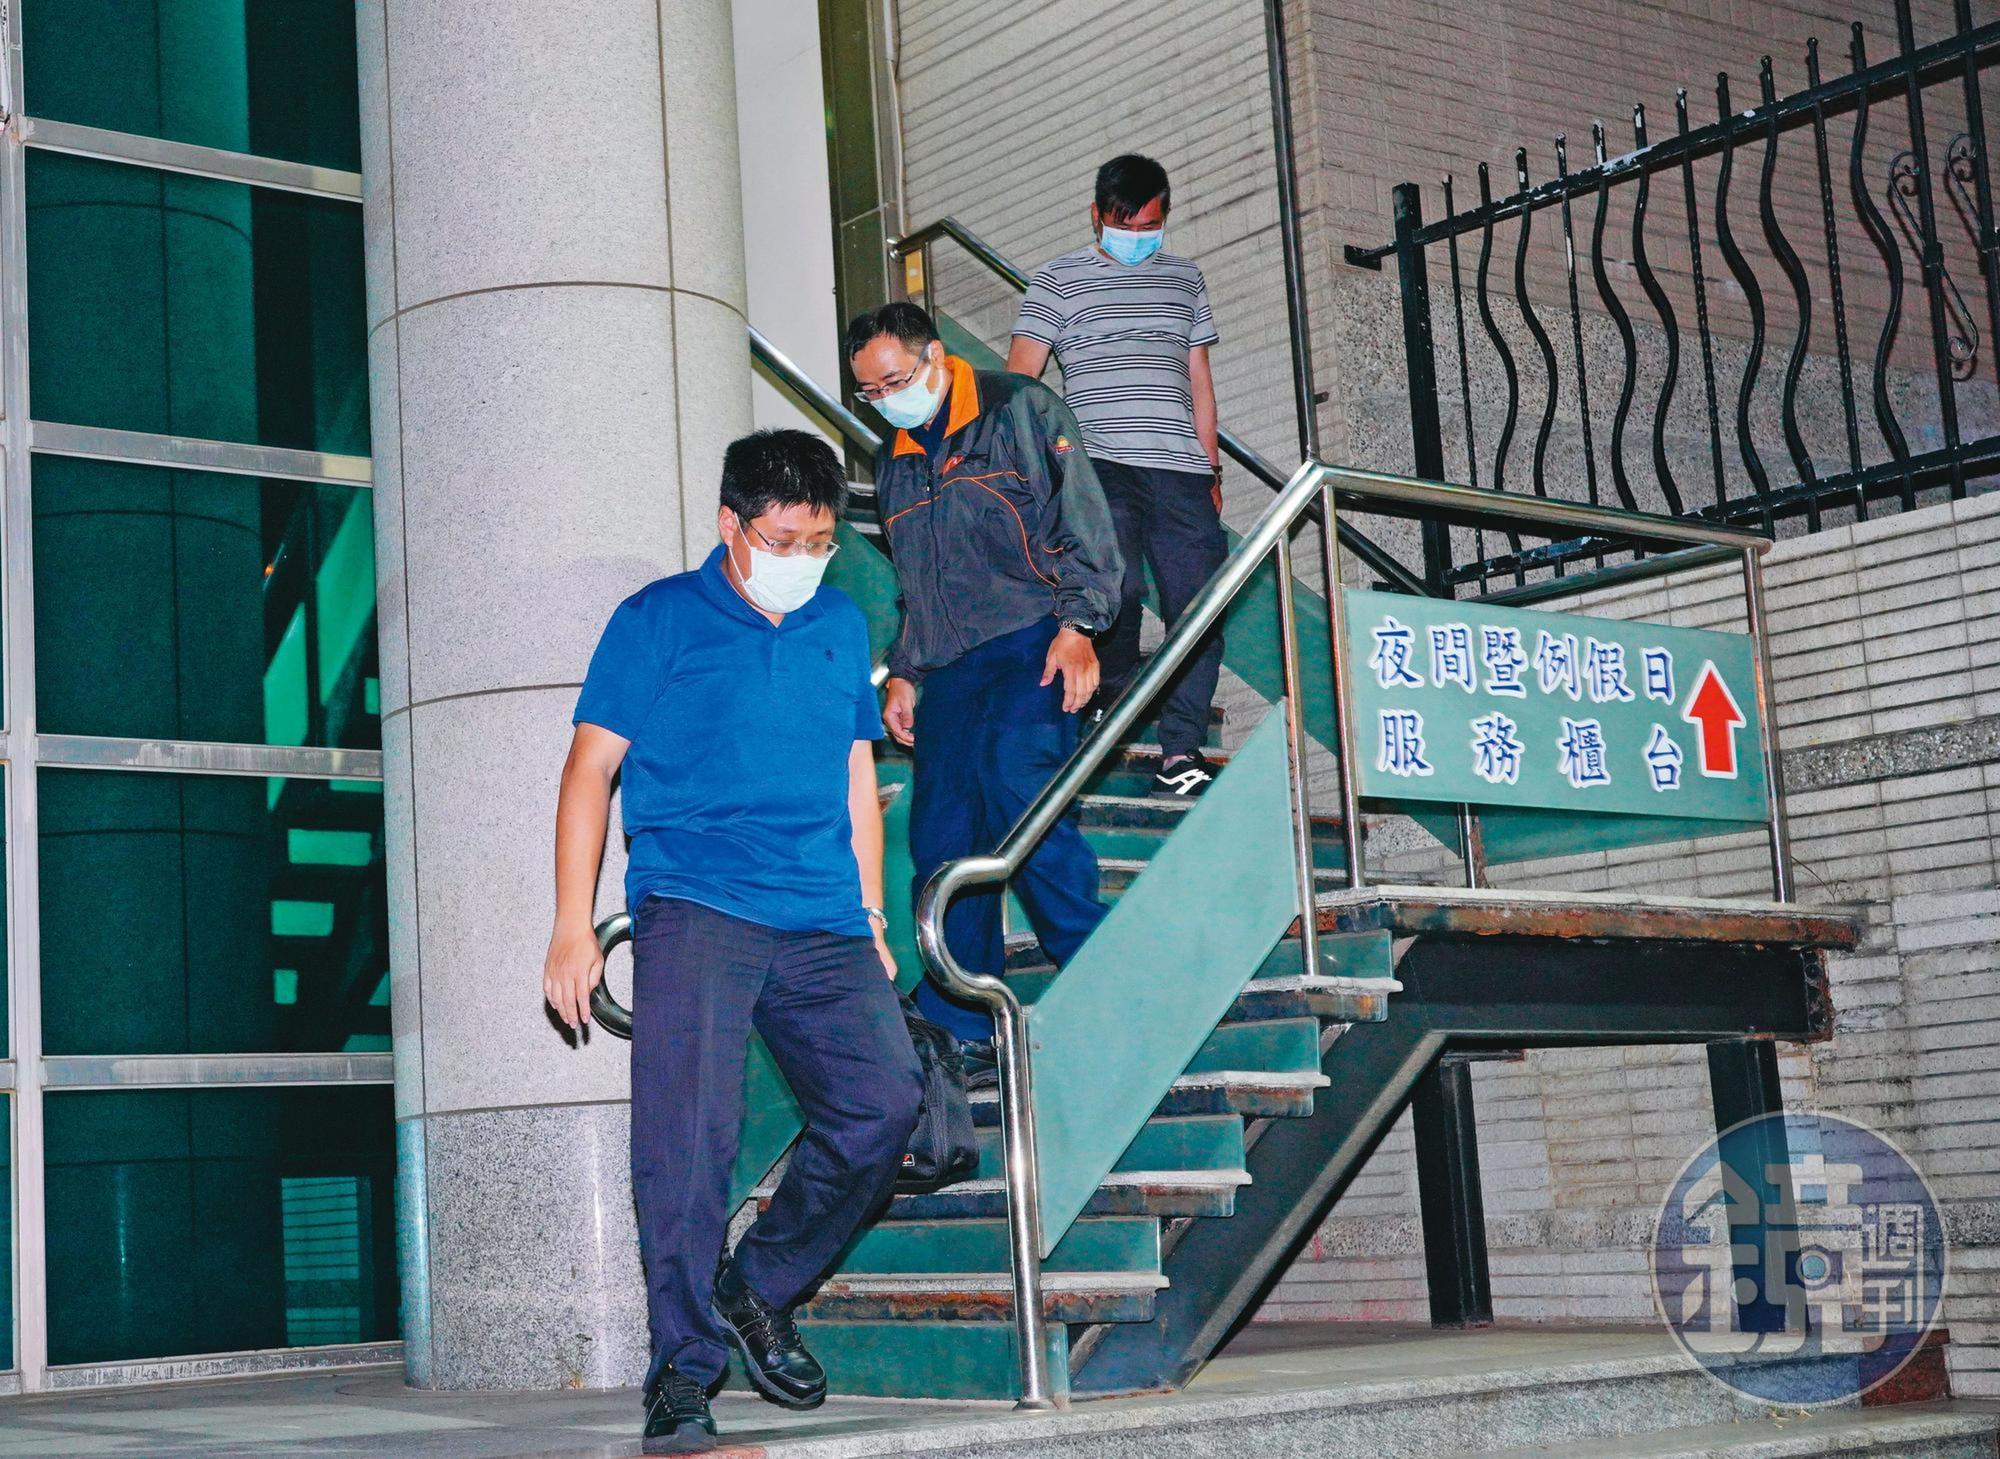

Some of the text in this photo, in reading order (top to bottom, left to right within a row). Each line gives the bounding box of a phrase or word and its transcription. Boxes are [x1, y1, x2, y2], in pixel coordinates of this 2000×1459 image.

[1371, 616, 1676, 705] 夜間暨例假日
[1376, 709, 1683, 793] 服務櫃台
